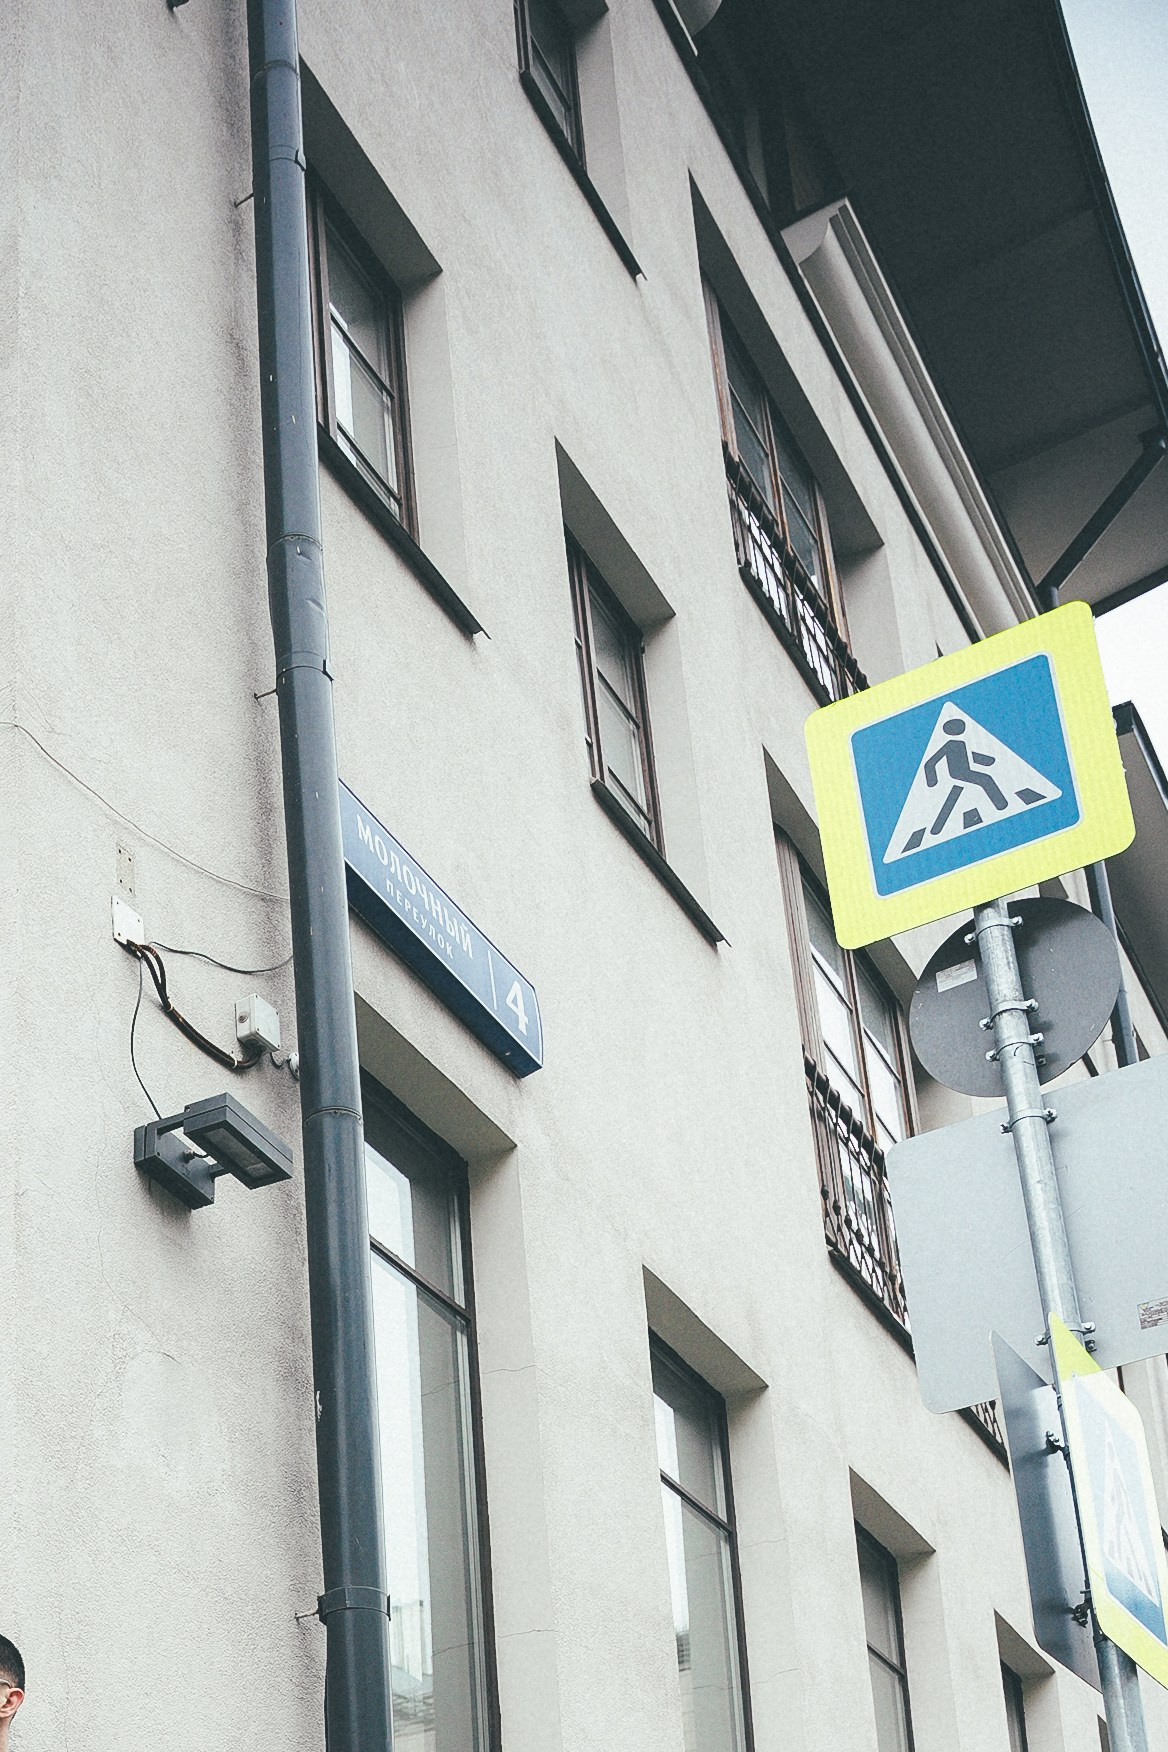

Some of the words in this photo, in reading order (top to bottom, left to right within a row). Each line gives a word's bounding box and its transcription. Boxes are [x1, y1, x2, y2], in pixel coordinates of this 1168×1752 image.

[357, 814, 473, 959] МОЛОЧНЫЙ
[386, 879, 454, 959] ПЕРЕУЛОК
[505, 980, 528, 1036] 4
